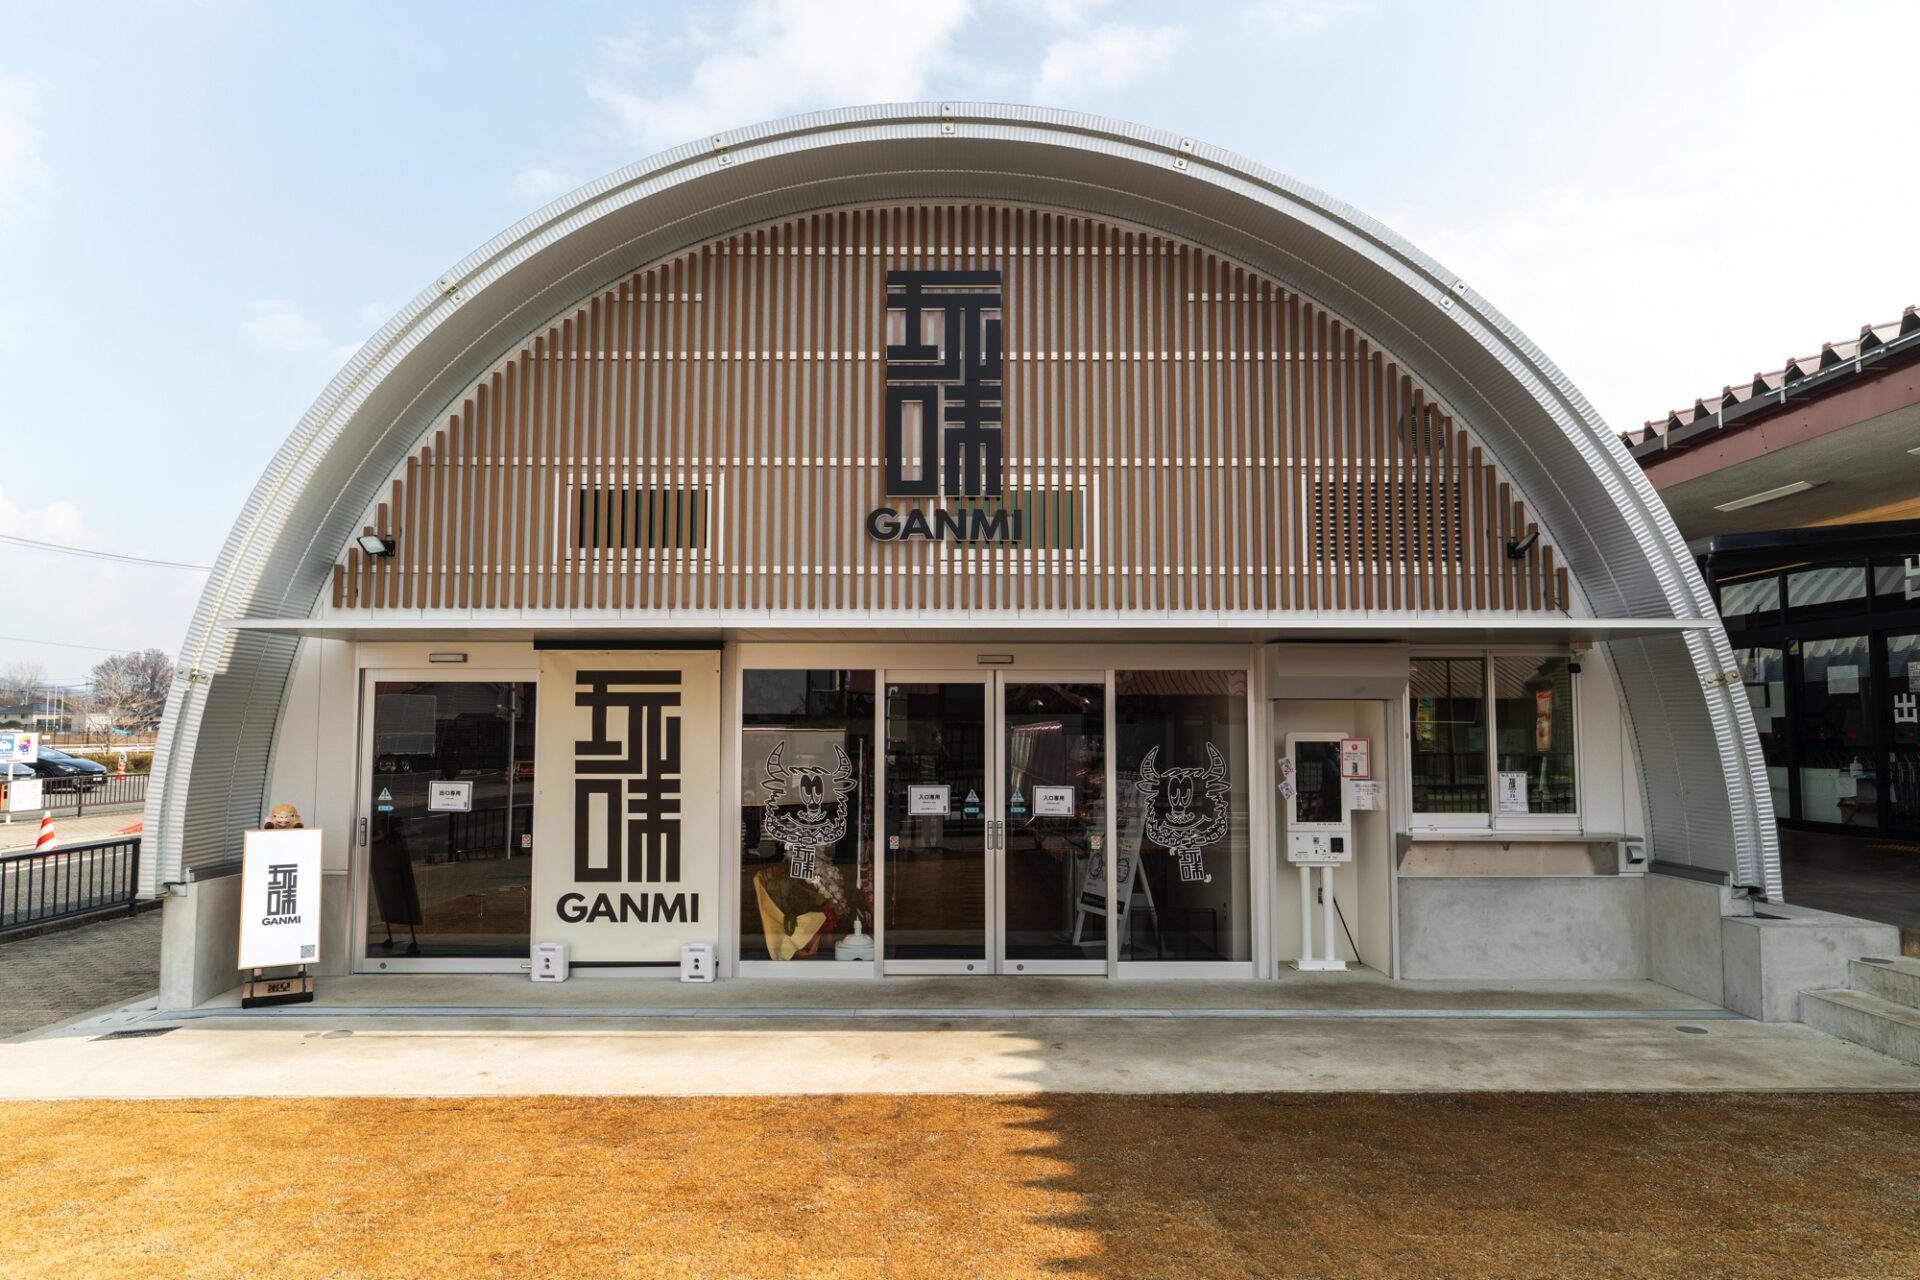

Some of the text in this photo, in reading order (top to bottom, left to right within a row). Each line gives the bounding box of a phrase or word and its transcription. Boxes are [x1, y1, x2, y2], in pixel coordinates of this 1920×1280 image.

[867, 507, 1023, 542] GANMI
[262, 916, 302, 926] GANMI
[557, 893, 699, 923] GANMI
